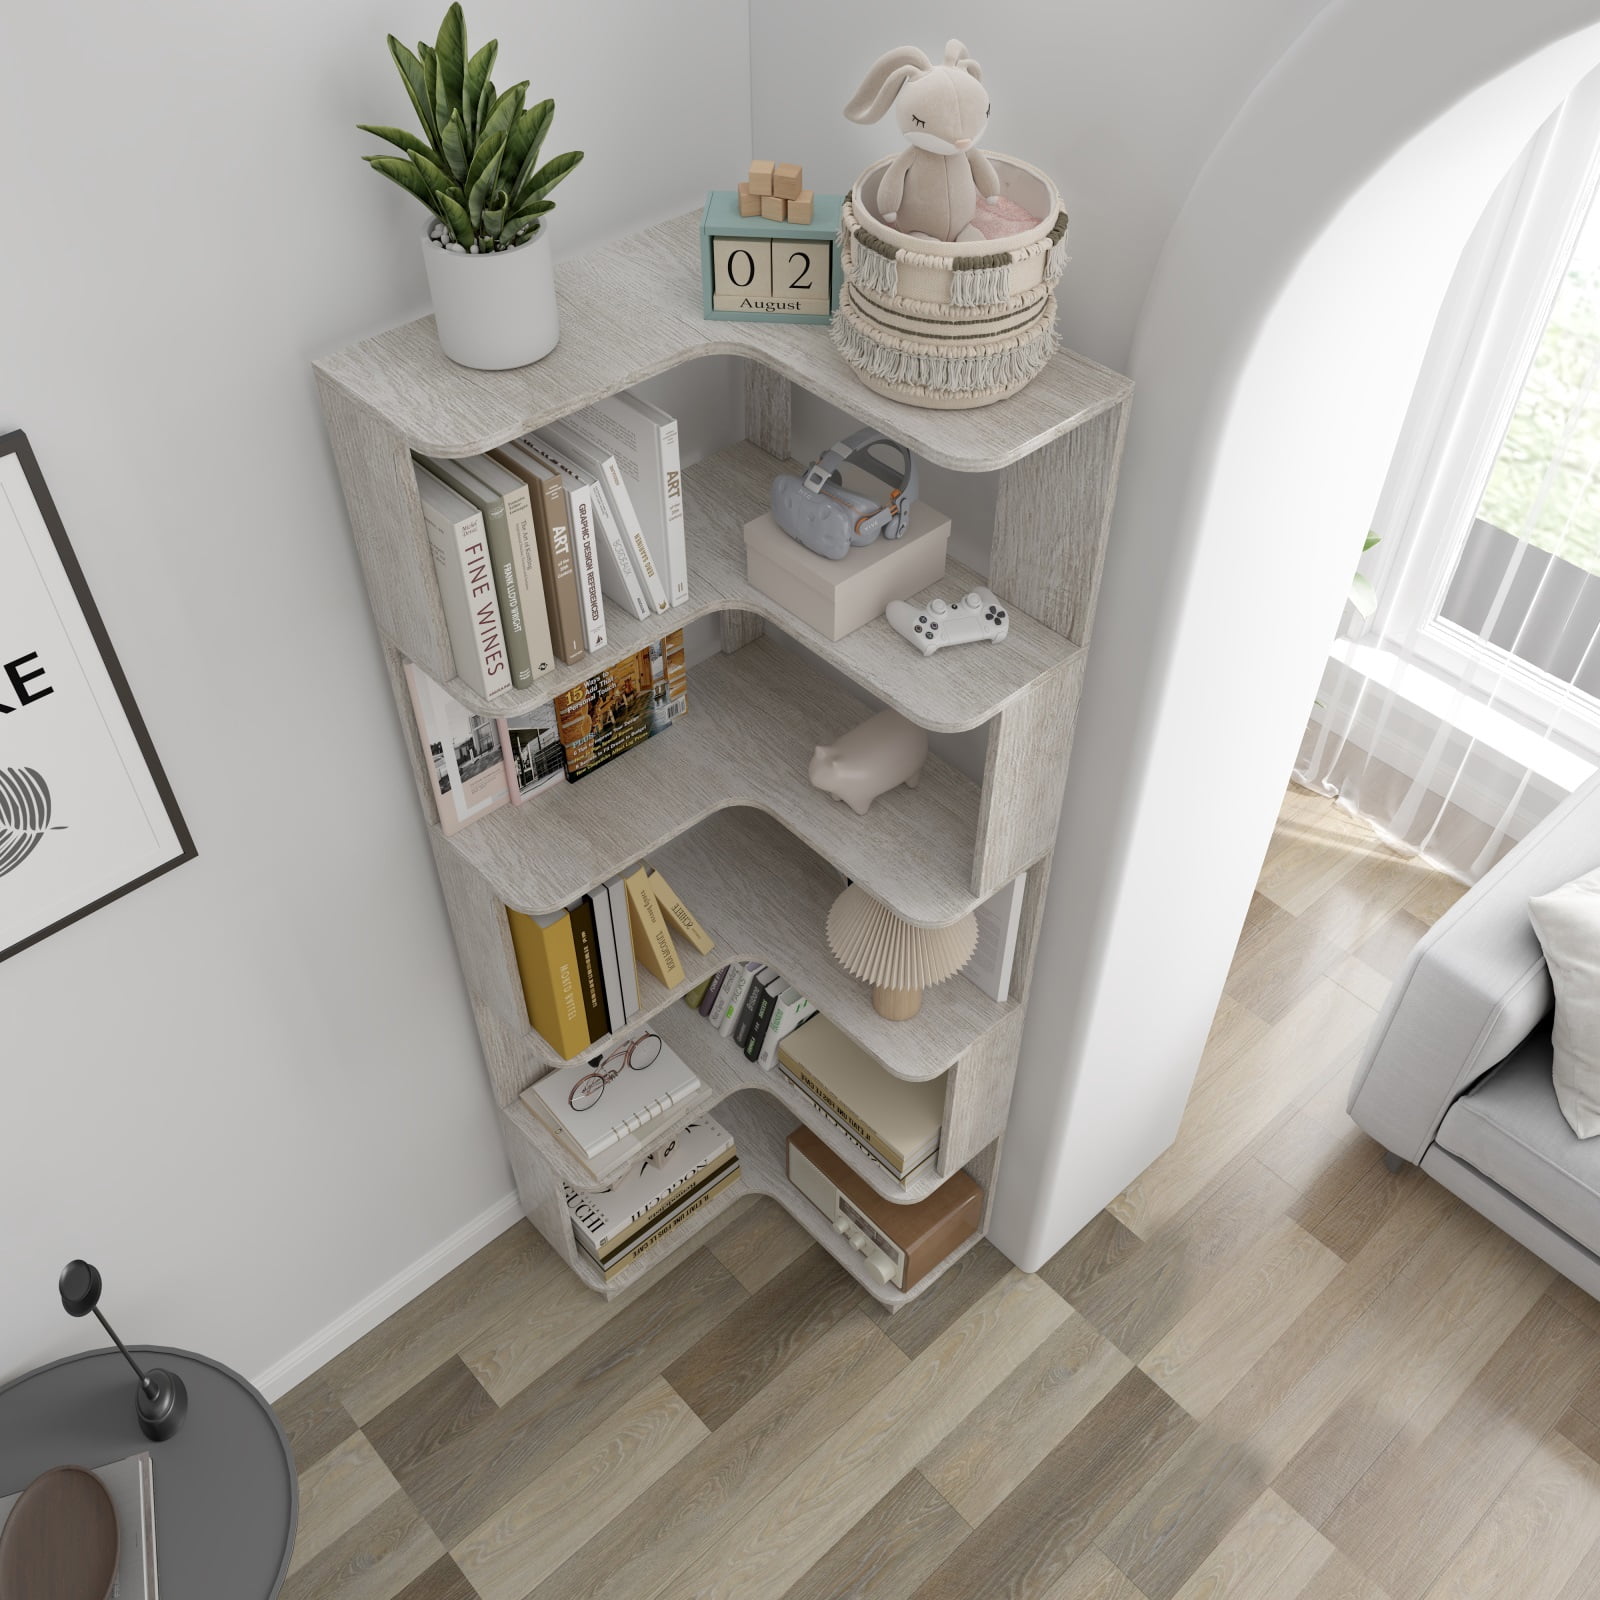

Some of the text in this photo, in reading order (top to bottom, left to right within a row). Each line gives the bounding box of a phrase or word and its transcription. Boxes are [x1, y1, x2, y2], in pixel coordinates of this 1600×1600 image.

[740, 298, 802, 313] August
[667, 470, 681, 499] ART
[520, 520, 528, 531] The
[579, 503, 590, 541] GRAPHIC
[552, 526, 569, 555] ART
[583, 541, 594, 571] DESIGN
[645, 561, 656, 578] EERO
[464, 542, 490, 598] FINE
[477, 601, 504, 676] WINES
[503, 563, 521, 633] FRANK LLOYD WRIGHT
[587, 571, 600, 621] REFERENCED
[0, 650, 54, 714] E
[566, 685, 584, 706] 15
[583, 675, 602, 689] Ways
[585, 685, 598, 697] Add
[567, 682, 617, 713] Personal Touch
[657, 1225, 672, 1237] FOIS
